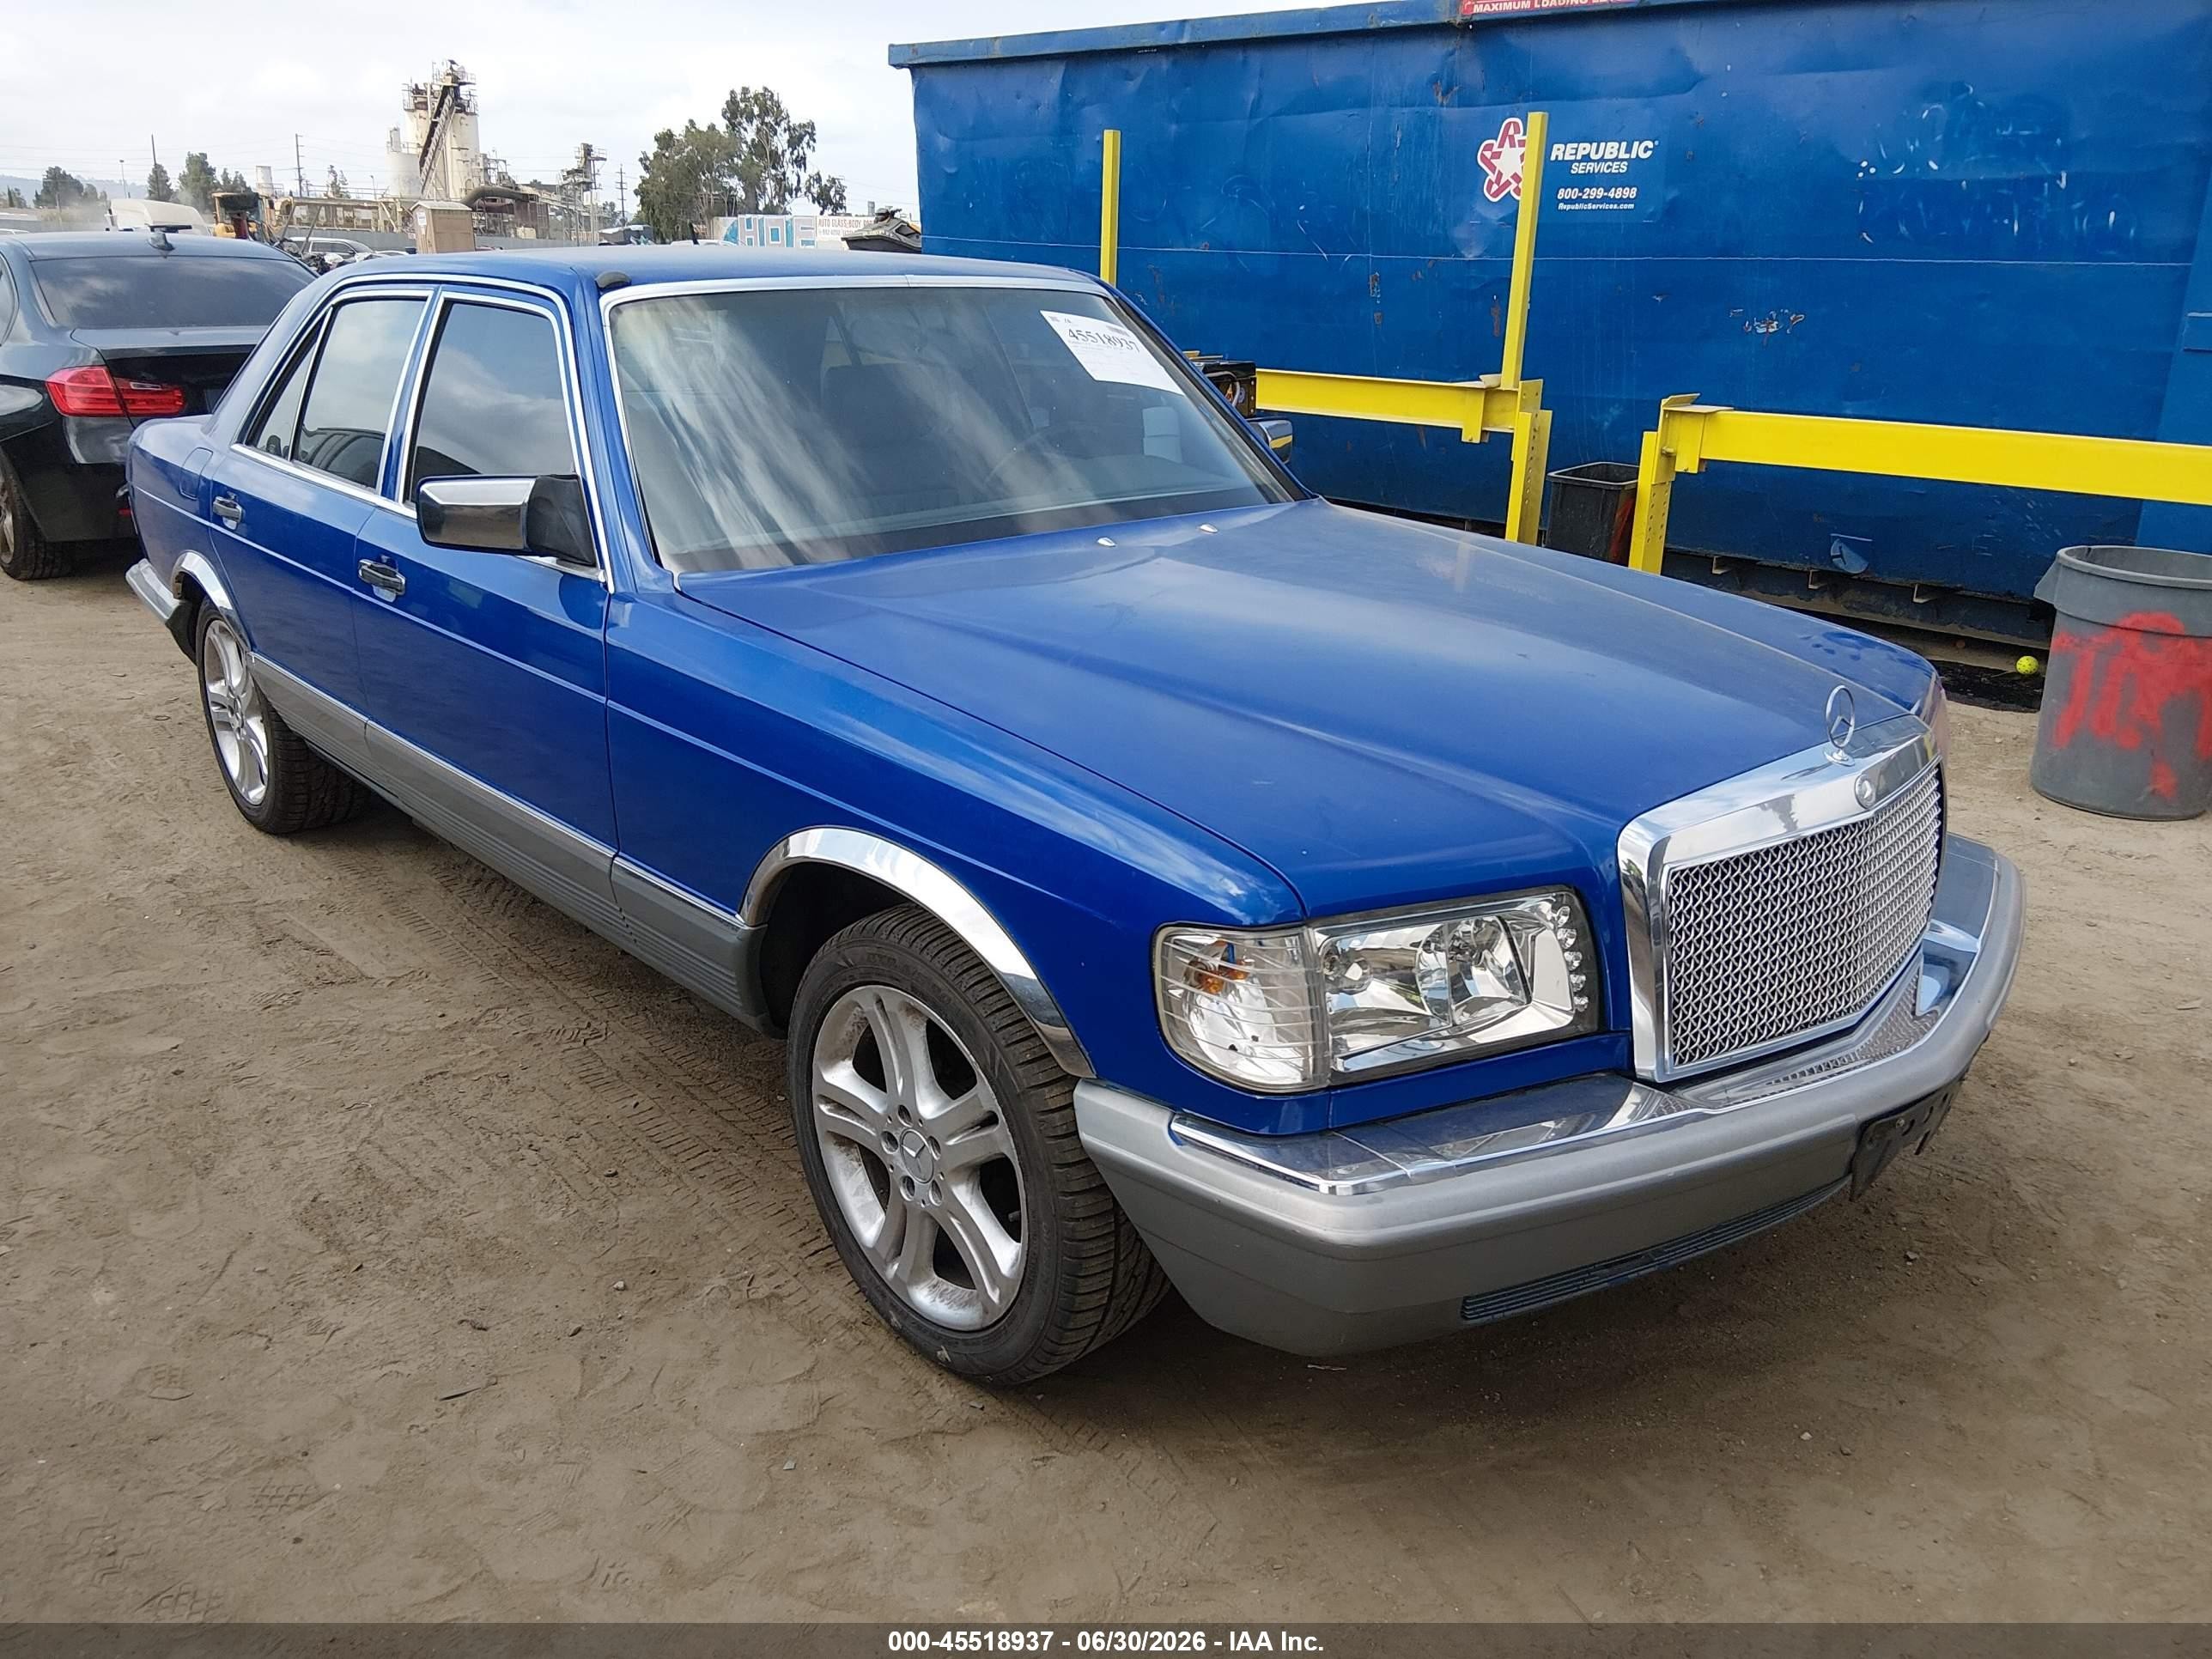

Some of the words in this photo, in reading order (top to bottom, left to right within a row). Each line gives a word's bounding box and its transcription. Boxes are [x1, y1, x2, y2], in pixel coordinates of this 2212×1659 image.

[1474, 1, 1531, 14] MAXIMUM
[1550, 140, 1654, 161] REPUBLIC
[1571, 161, 1628, 174] SERVICES
[1557, 186, 1638, 199] 800-299-4898
[1558, 202, 1635, 211] RepublicServices.com
[1067, 328, 1140, 353] 45518937
